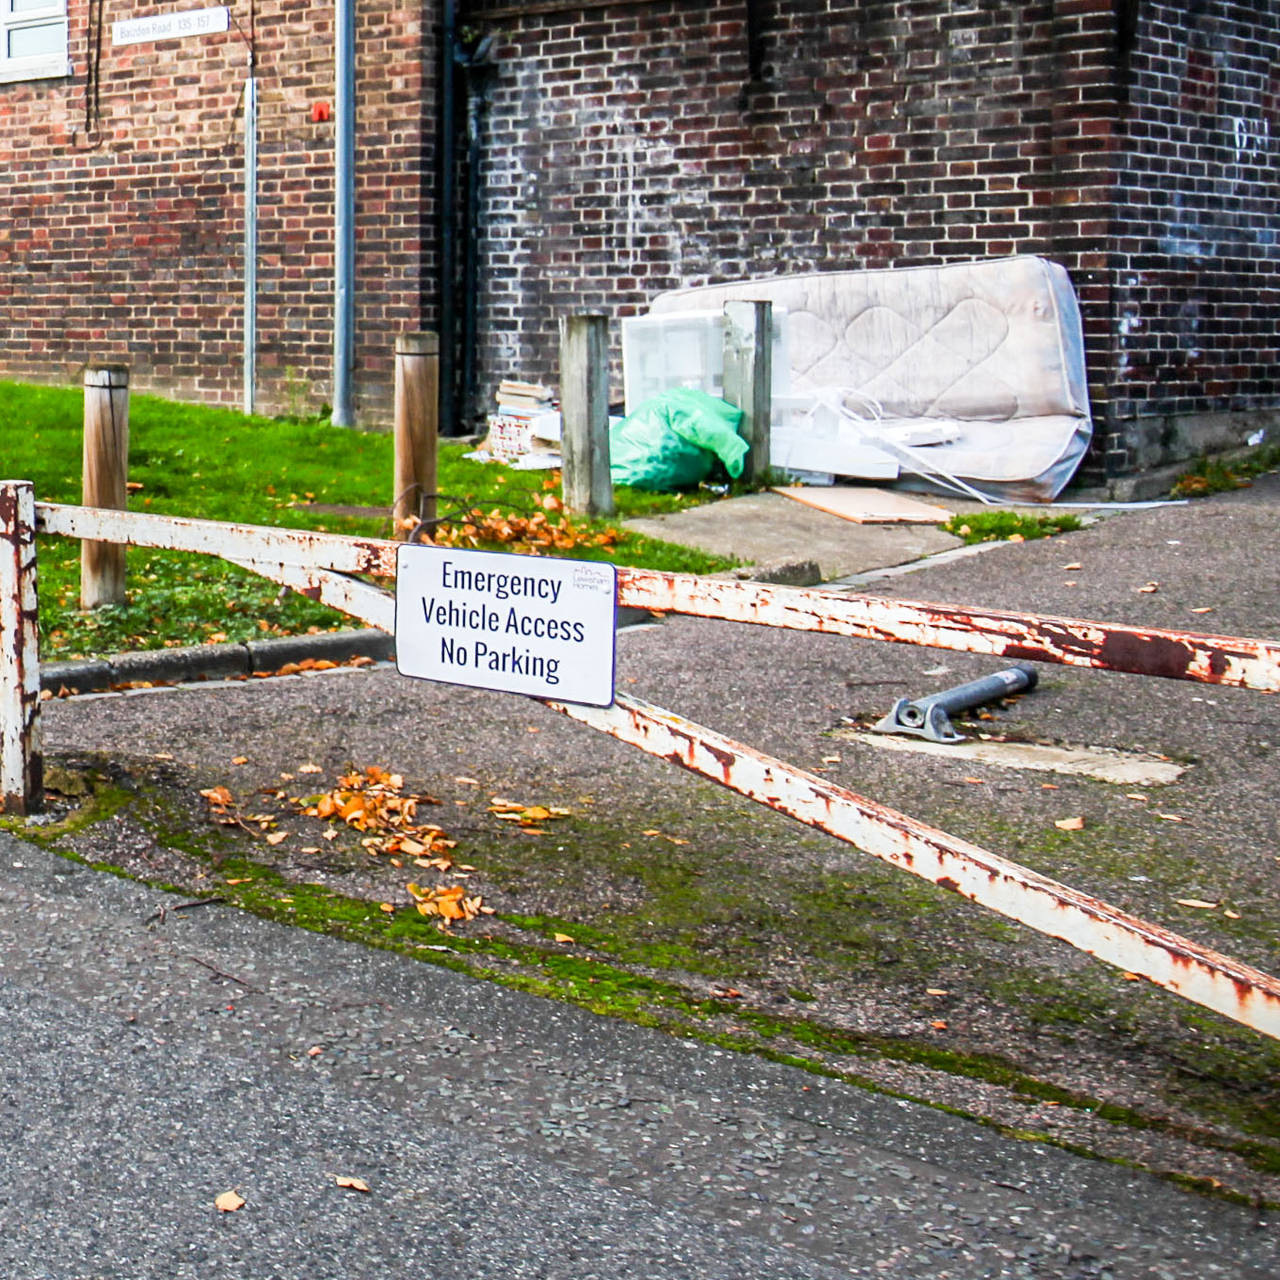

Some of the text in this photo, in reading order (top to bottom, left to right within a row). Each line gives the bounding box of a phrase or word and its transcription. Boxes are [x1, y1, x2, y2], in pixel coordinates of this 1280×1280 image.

[442, 561, 562, 604] Emergency
[422, 597, 585, 643] Vehicle Access
[441, 637, 561, 685] No Parking
